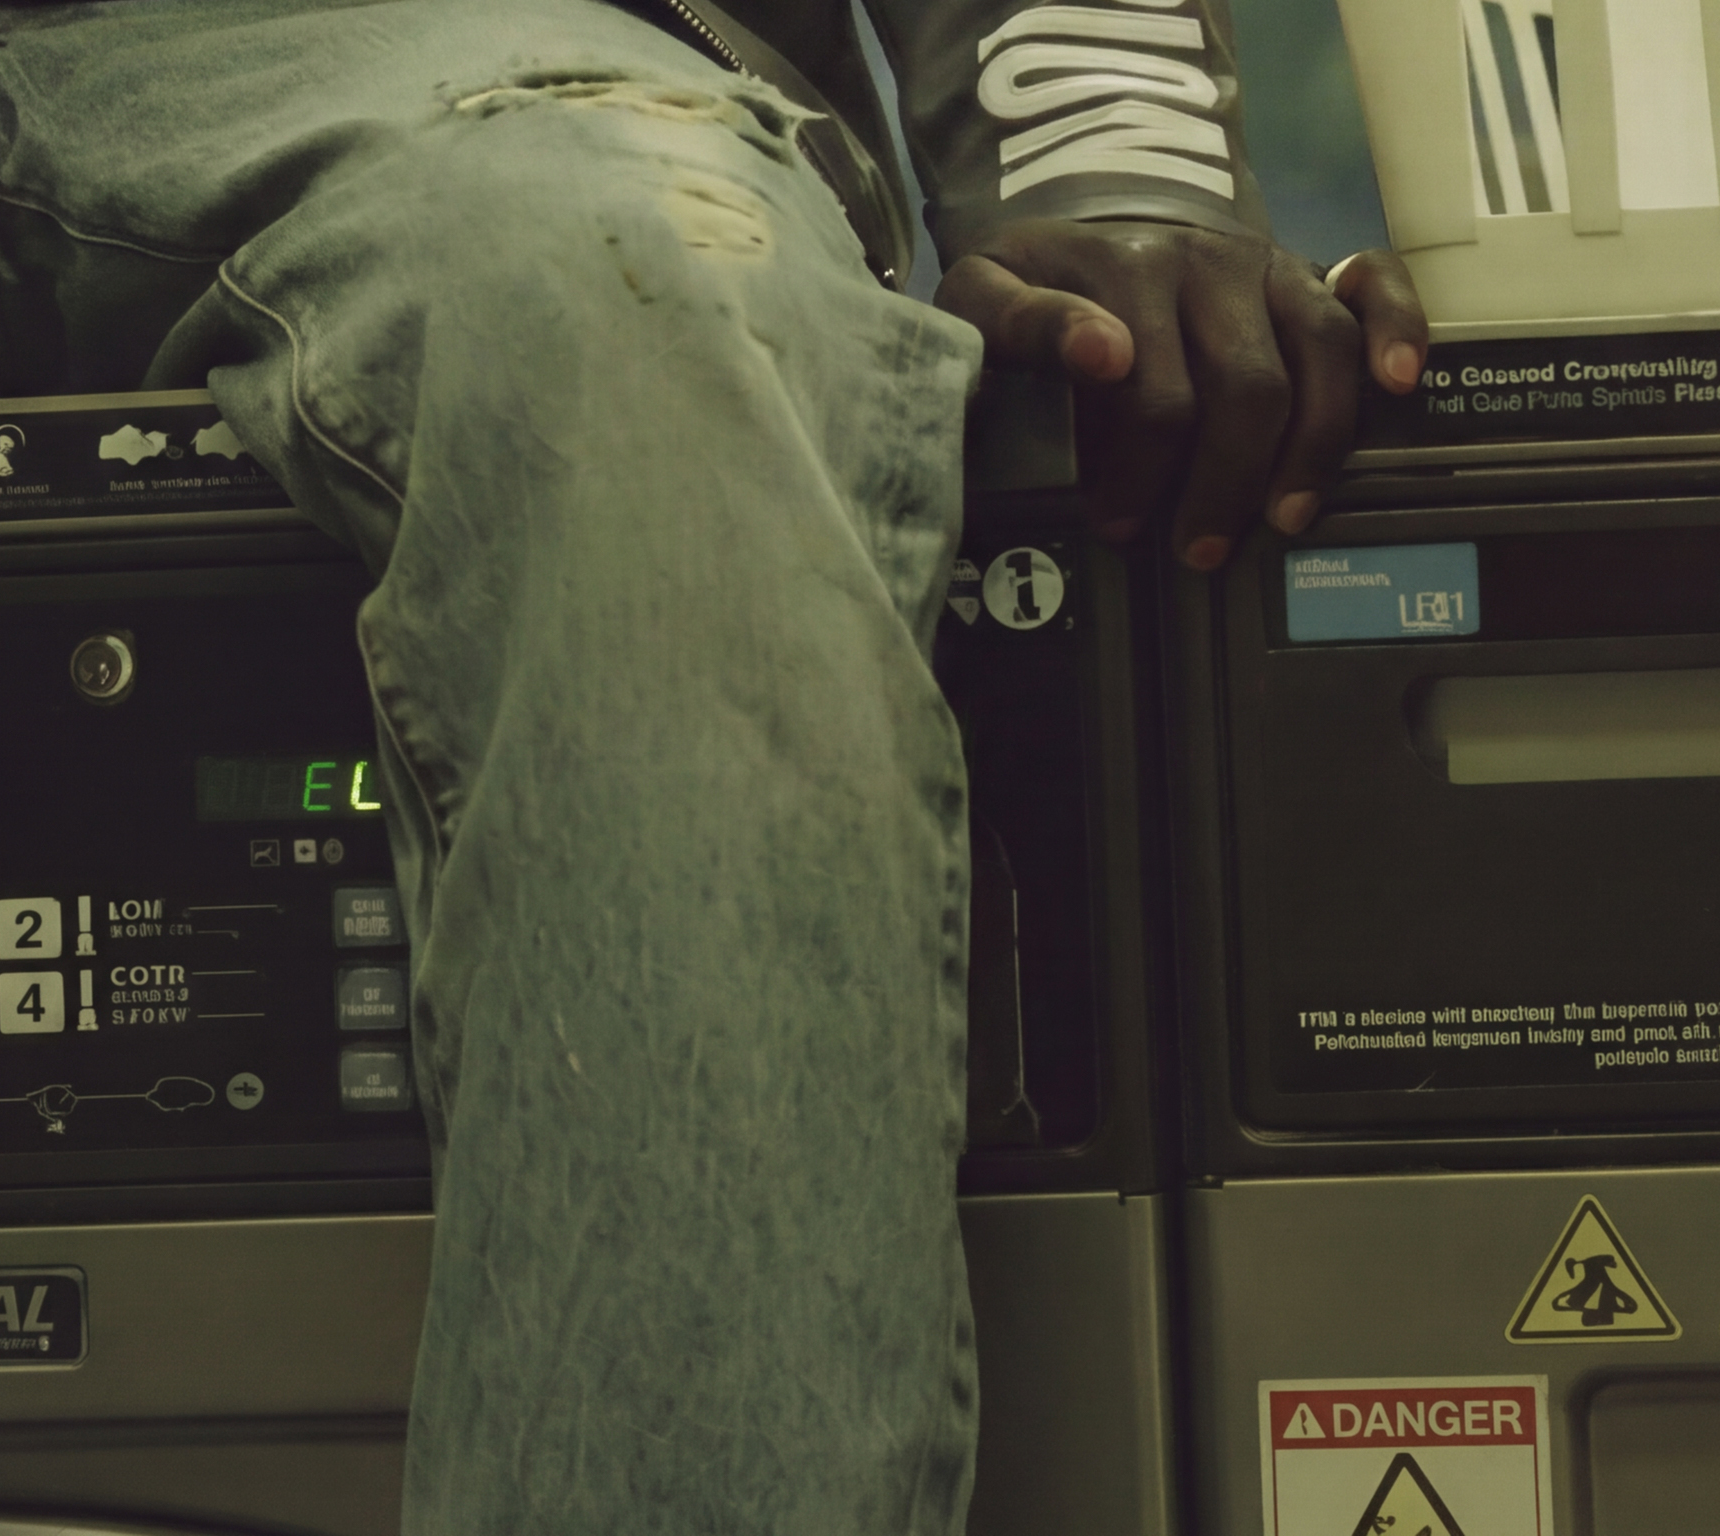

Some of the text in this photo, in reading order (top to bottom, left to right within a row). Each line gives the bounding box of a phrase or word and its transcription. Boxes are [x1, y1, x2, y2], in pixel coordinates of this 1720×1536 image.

[13, 910, 44, 950] 2
[15, 983, 47, 1024] 4
[1332, 1399, 1524, 1439] DANGER
